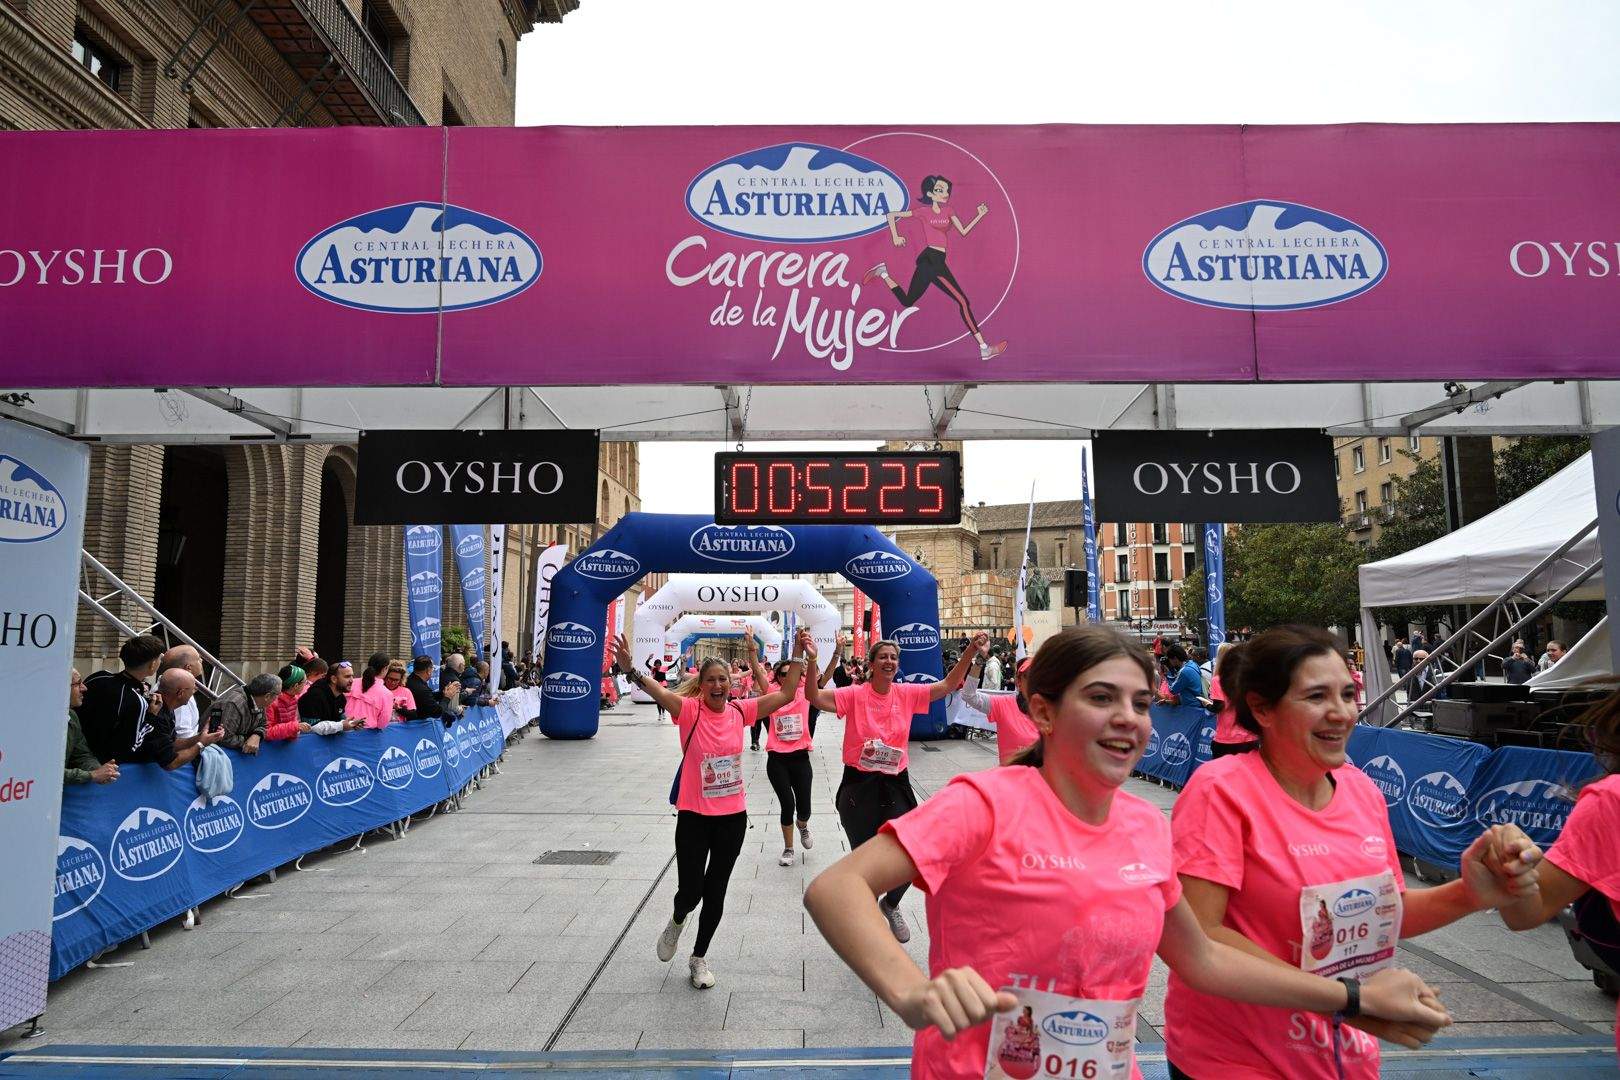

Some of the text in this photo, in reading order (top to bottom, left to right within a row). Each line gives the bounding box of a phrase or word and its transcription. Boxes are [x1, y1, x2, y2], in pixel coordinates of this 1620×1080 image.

[738, 177, 884, 187] CENTRAL LECHERA
[354, 240, 516, 252] CENTRAL LECHERA
[1199, 237, 1360, 249] CENTRAL LECHERA
[314, 243, 524, 285] ASTURIANA
[665, 235, 850, 288] Carrera
[1162, 241, 1370, 282] ASTURIANA
[1509, 240, 1620, 278] OYS
[709, 290, 777, 327] de la
[771, 282, 920, 372] Mujer
[396, 460, 564, 496] OYSHO
[1133, 461, 1301, 495] OYSHO
[697, 532, 788, 552] ASTURIANA
[578, 560, 635, 573] ASTURIANA
[851, 563, 908, 574] ASTURIANA
[697, 585, 779, 603] OYSHO
[322, 775, 371, 799] ASTURIANA
[253, 791, 309, 821] ASTURIANA
[189, 814, 242, 843] ASTURIANA
[118, 832, 182, 871] ASTURIANA
[1336, 922, 1369, 944] 016
[1344, 944, 1358, 957] 117
[1045, 1053, 1098, 1080] 016
